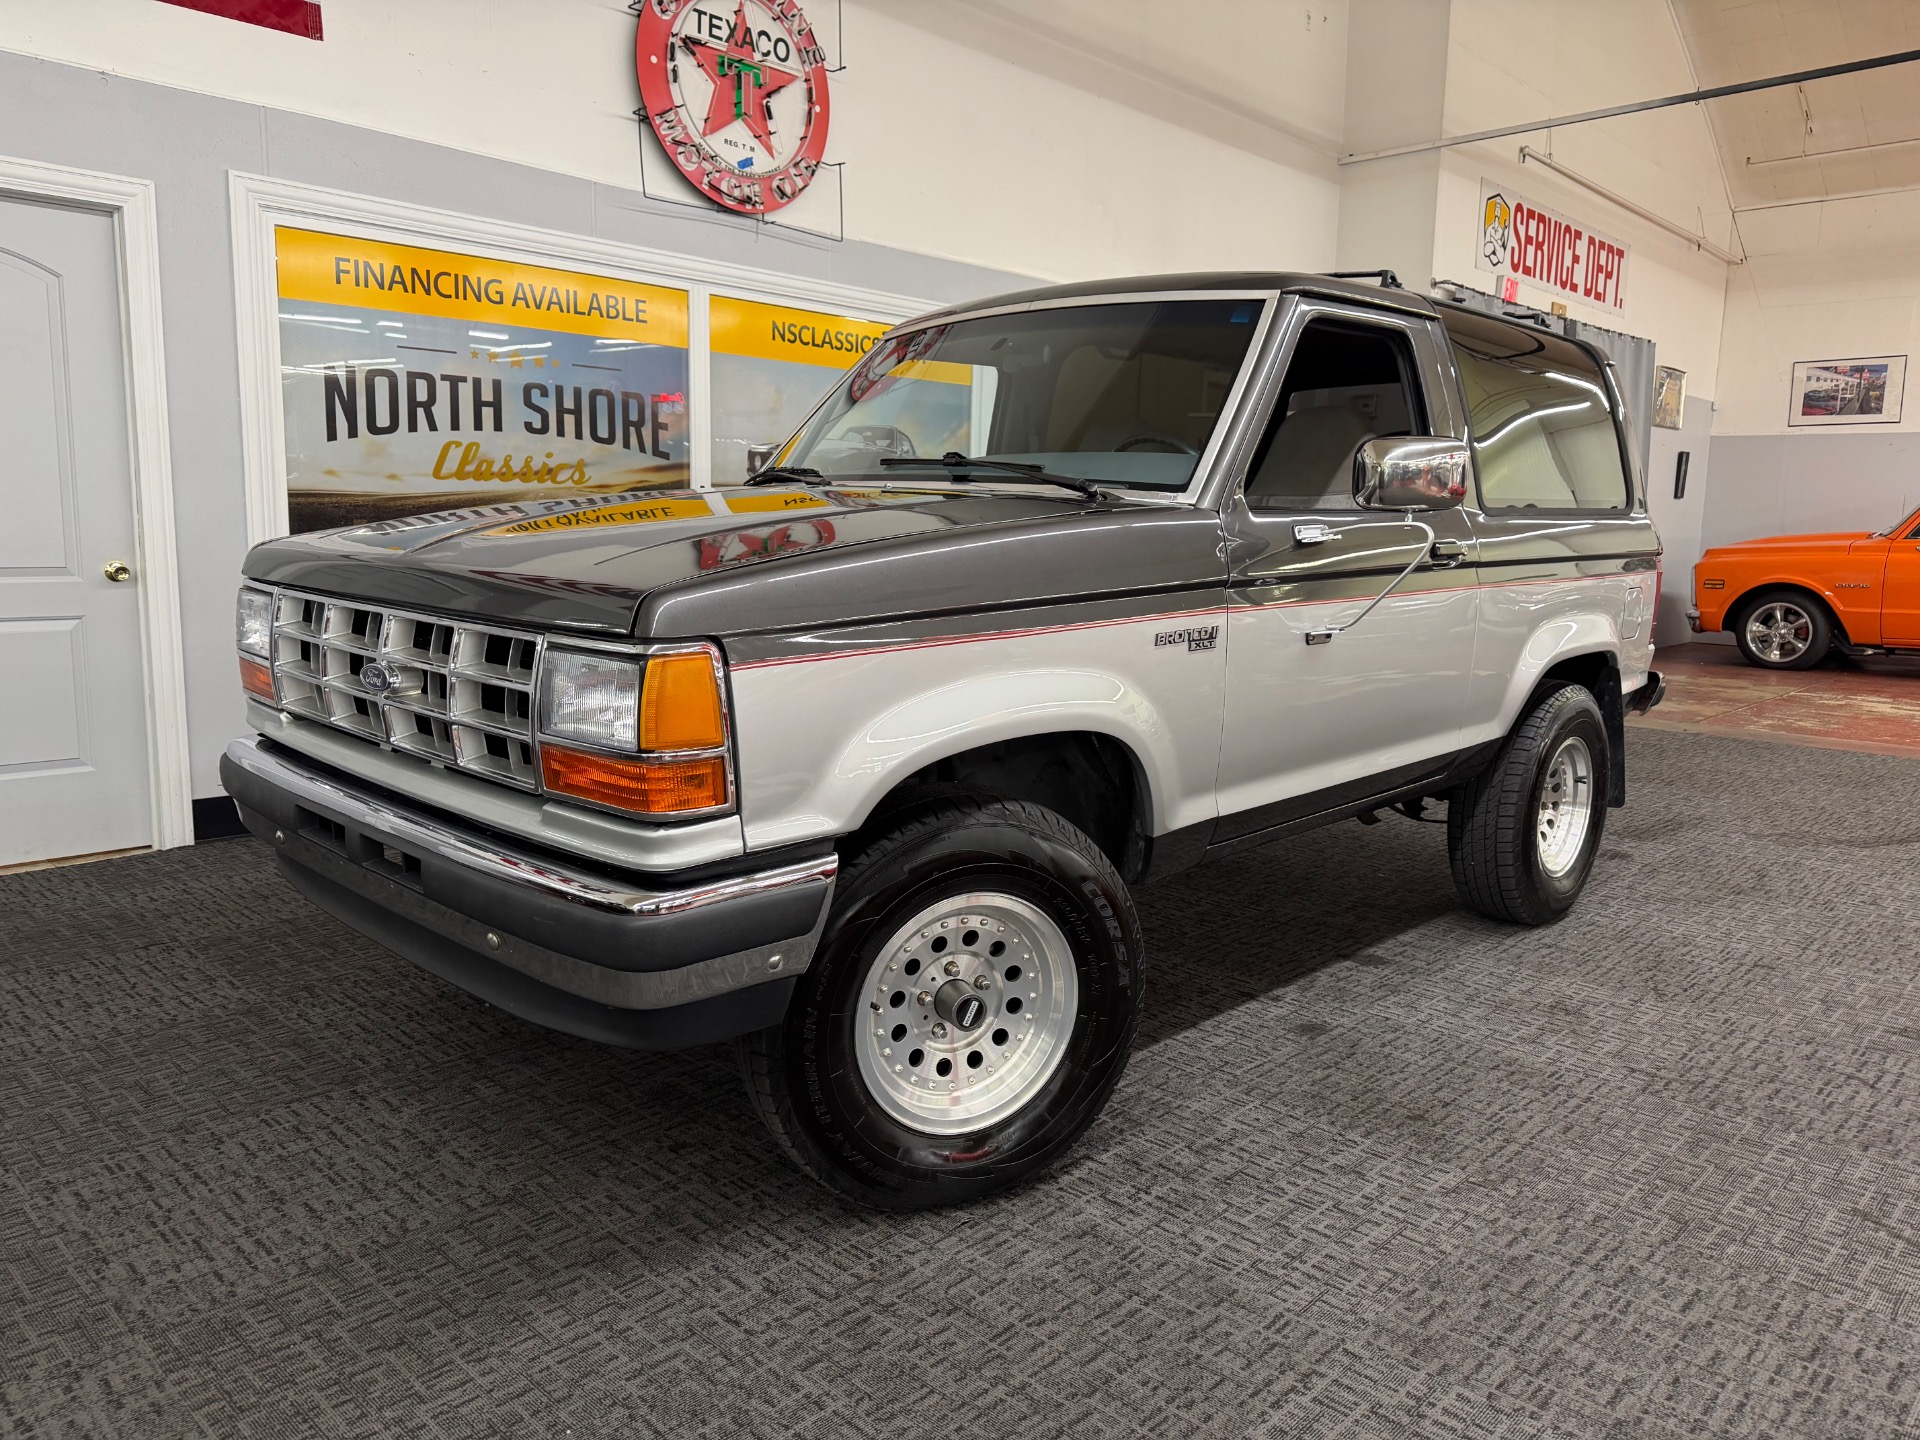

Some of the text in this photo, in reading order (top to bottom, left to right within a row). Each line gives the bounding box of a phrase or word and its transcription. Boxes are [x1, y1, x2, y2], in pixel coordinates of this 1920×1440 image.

[692, 7, 790, 63] TEXACO
[723, 138, 741, 149] REG.
[1510, 202, 1625, 310] SERVICE DEPT.
[333, 256, 649, 324] FINANCING AVAILABLE
[324, 365, 671, 461] NORTH SHORE
[432, 440, 592, 487] Classics
[1194, 640, 1215, 650] XLT
[365, 668, 383, 687] Ford
[1080, 880, 1130, 986] CORSA
